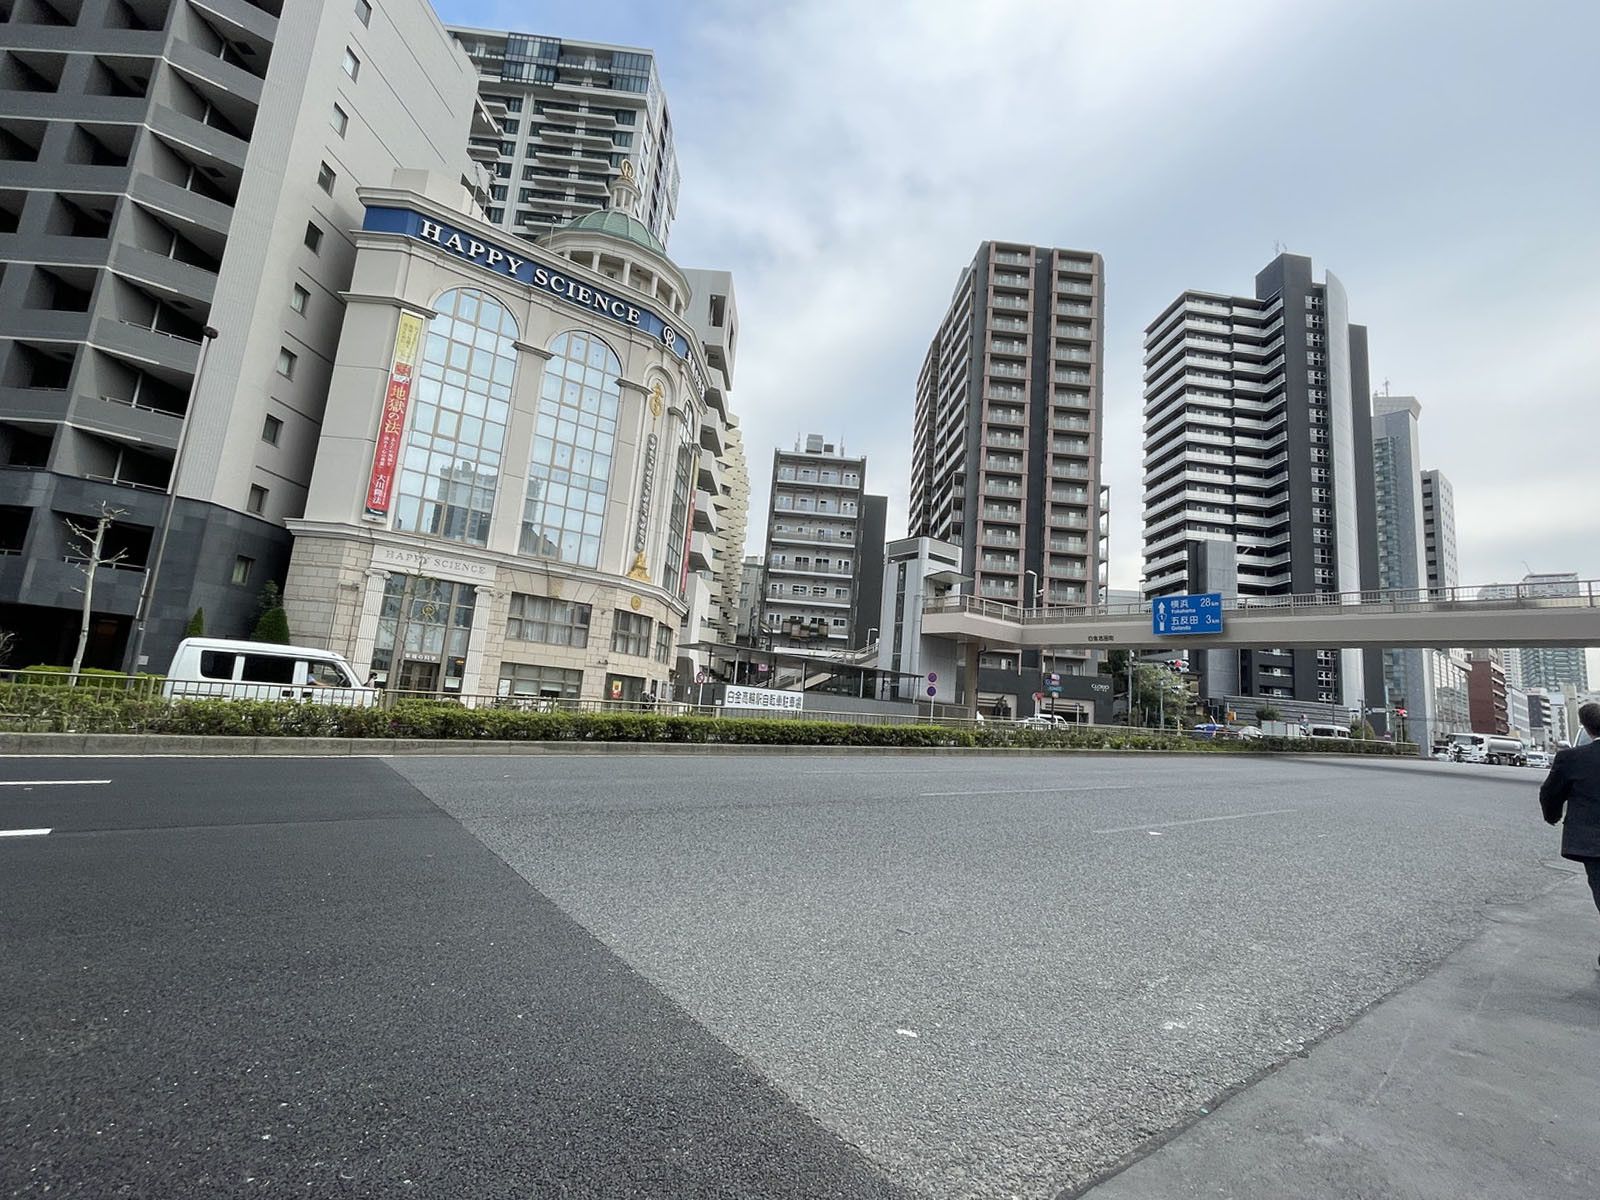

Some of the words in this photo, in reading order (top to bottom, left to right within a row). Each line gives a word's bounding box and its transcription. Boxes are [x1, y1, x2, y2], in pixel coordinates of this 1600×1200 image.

[420, 219, 524, 275] HAPPY
[534, 268, 641, 325] SCIENCE
[384, 385, 407, 436] 地獄の法
[386, 550, 429, 565] HAPPY
[434, 559, 487, 575] SCIENCE
[1170, 599, 1189, 609] 横浜
[1171, 616, 1198, 626] 五反田
